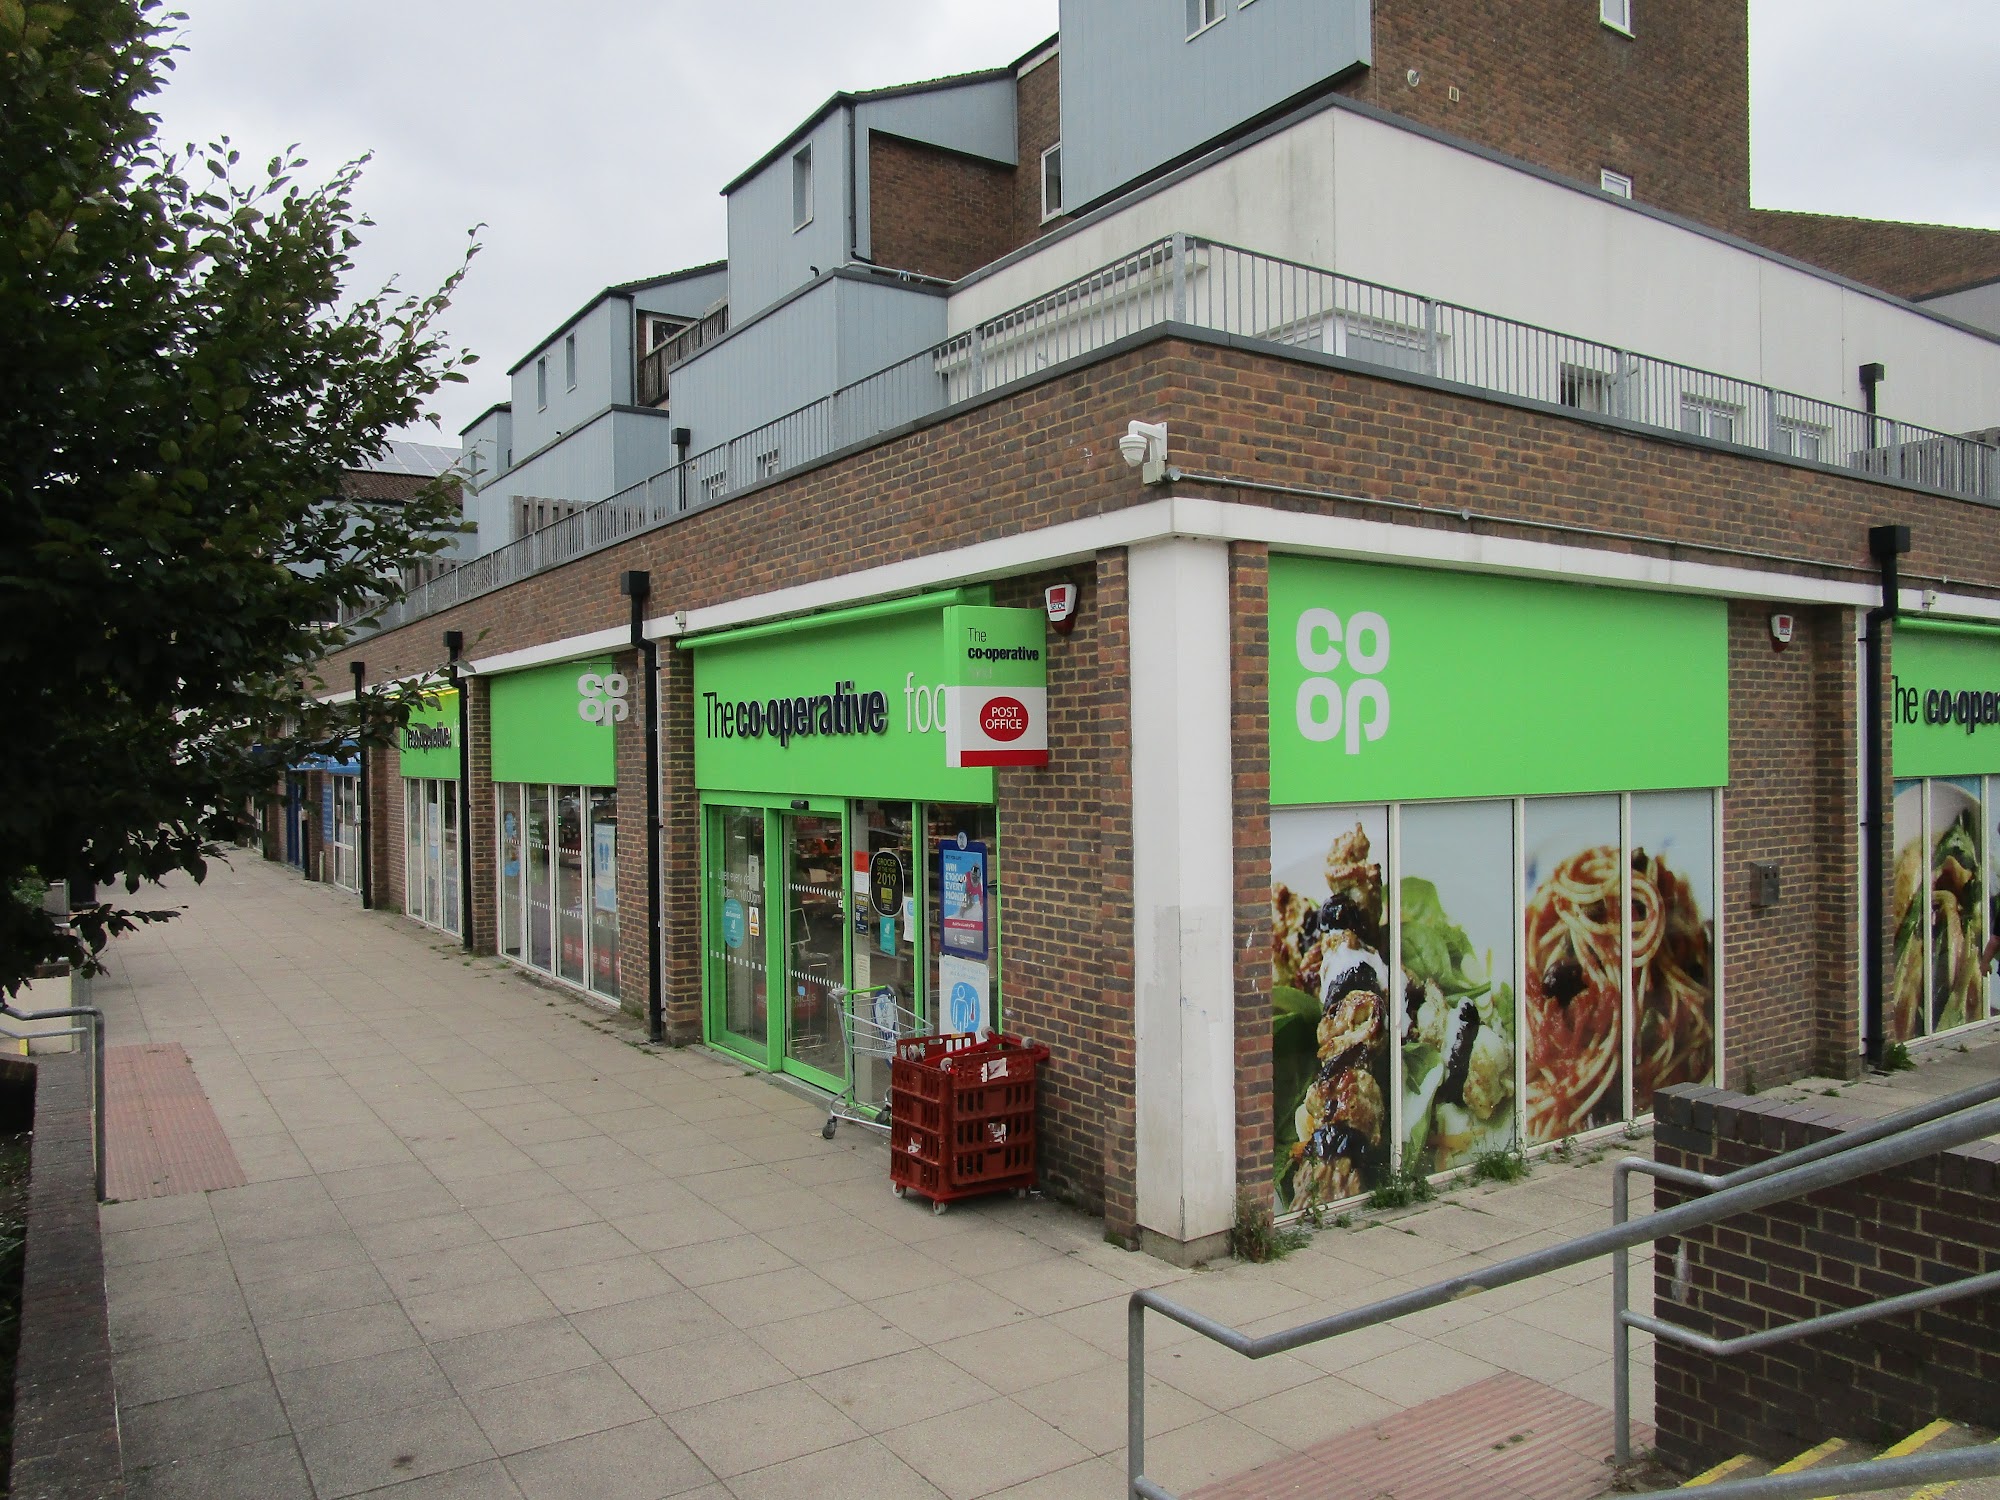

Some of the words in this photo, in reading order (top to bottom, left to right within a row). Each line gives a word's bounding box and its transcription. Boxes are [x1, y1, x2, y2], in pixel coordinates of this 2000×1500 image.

[967, 627, 987, 642] The
[967, 646, 1039, 662] co-operative
[703, 691, 734, 738] The
[735, 680, 888, 748] co-operative
[904, 672, 948, 733] foo
[991, 706, 1019, 718] POST
[985, 718, 1022, 730] OFFICE
[876, 872, 897, 887] 2019
